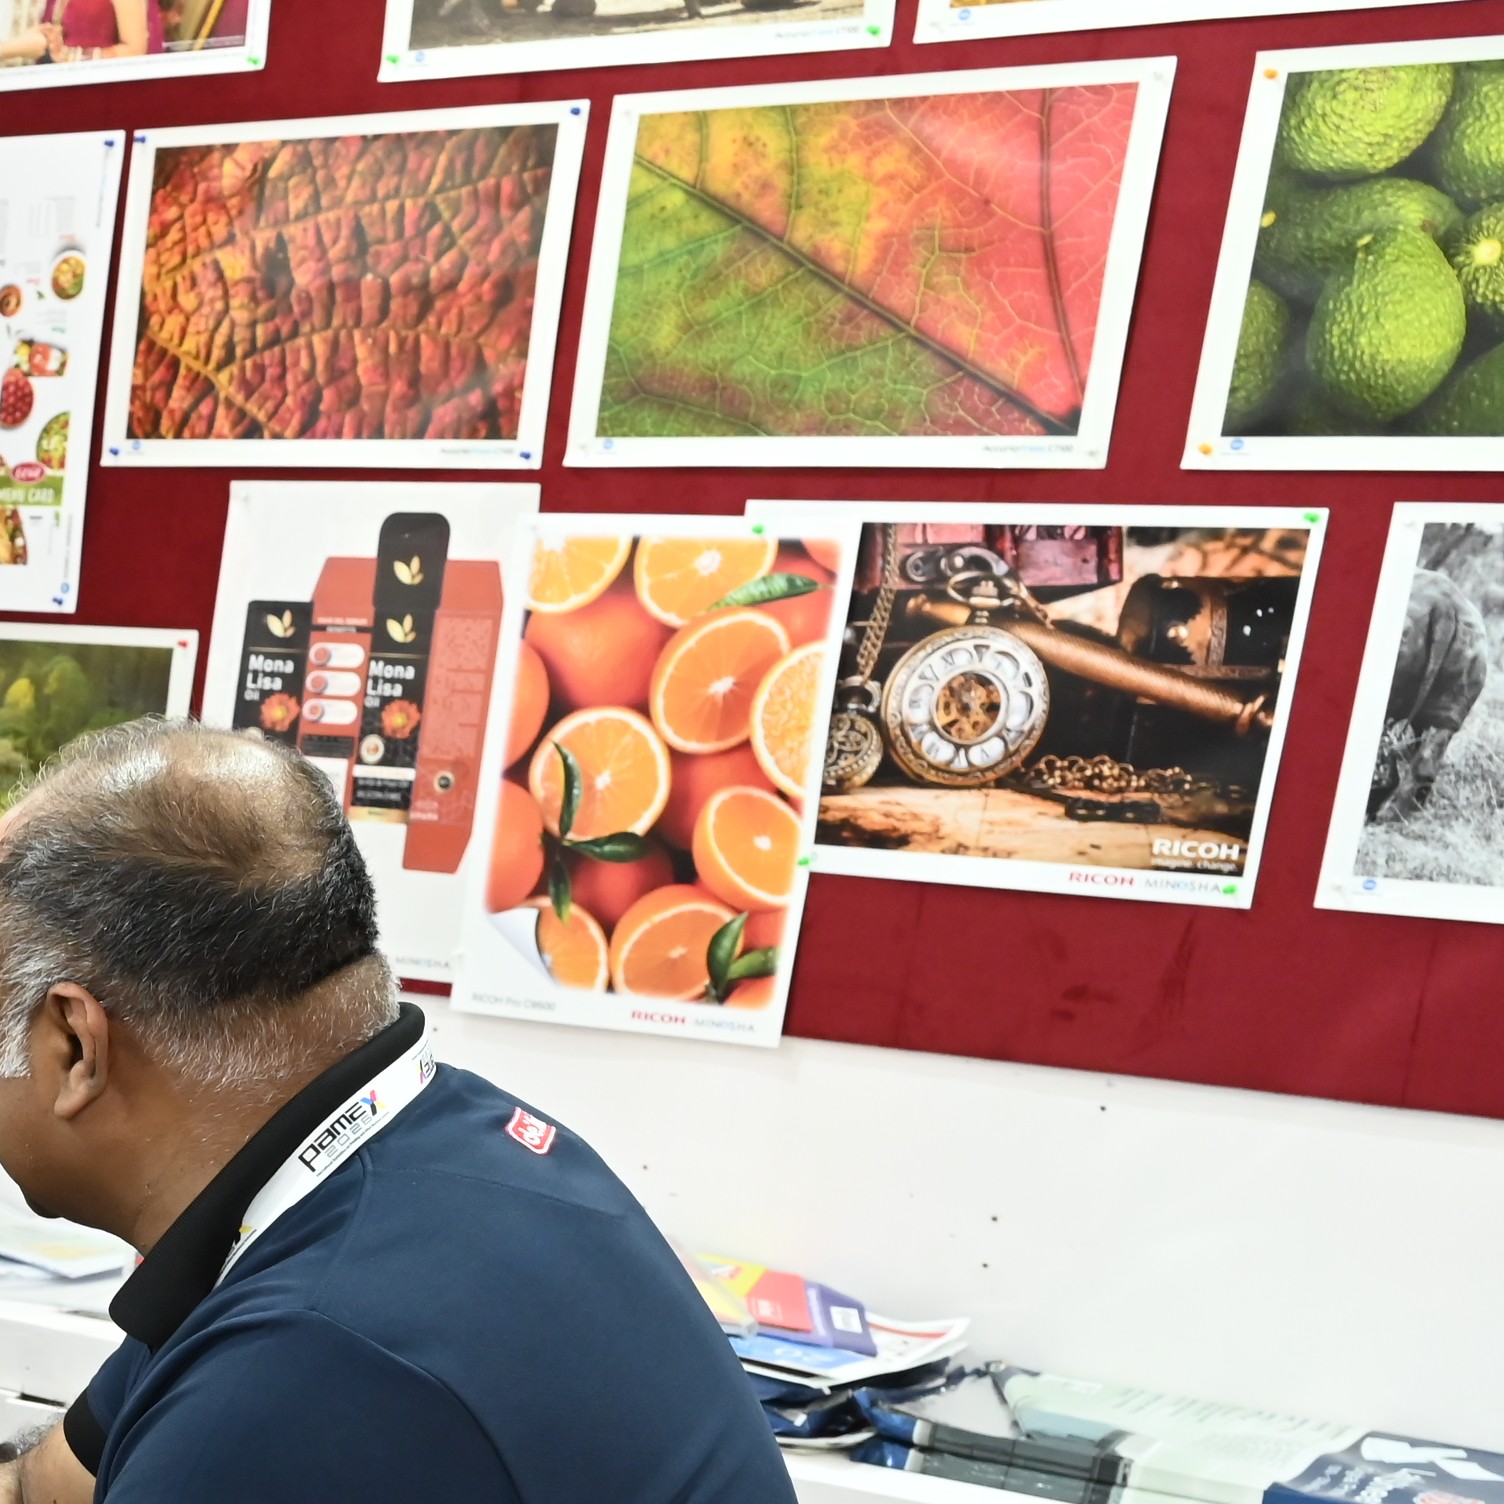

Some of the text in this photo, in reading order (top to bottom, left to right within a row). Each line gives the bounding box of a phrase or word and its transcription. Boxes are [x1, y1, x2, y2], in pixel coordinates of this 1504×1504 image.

[249, 654, 294, 674] Mona
[368, 660, 416, 680] Mona
[245, 672, 283, 691] Lisa
[366, 678, 403, 697] Lisa
[1152, 838, 1240, 861] RICOH
[1069, 871, 1222, 895] RICOH MINOSHA
[631, 1009, 686, 1026] RICOH
[327, 1115, 373, 1159] 2026
